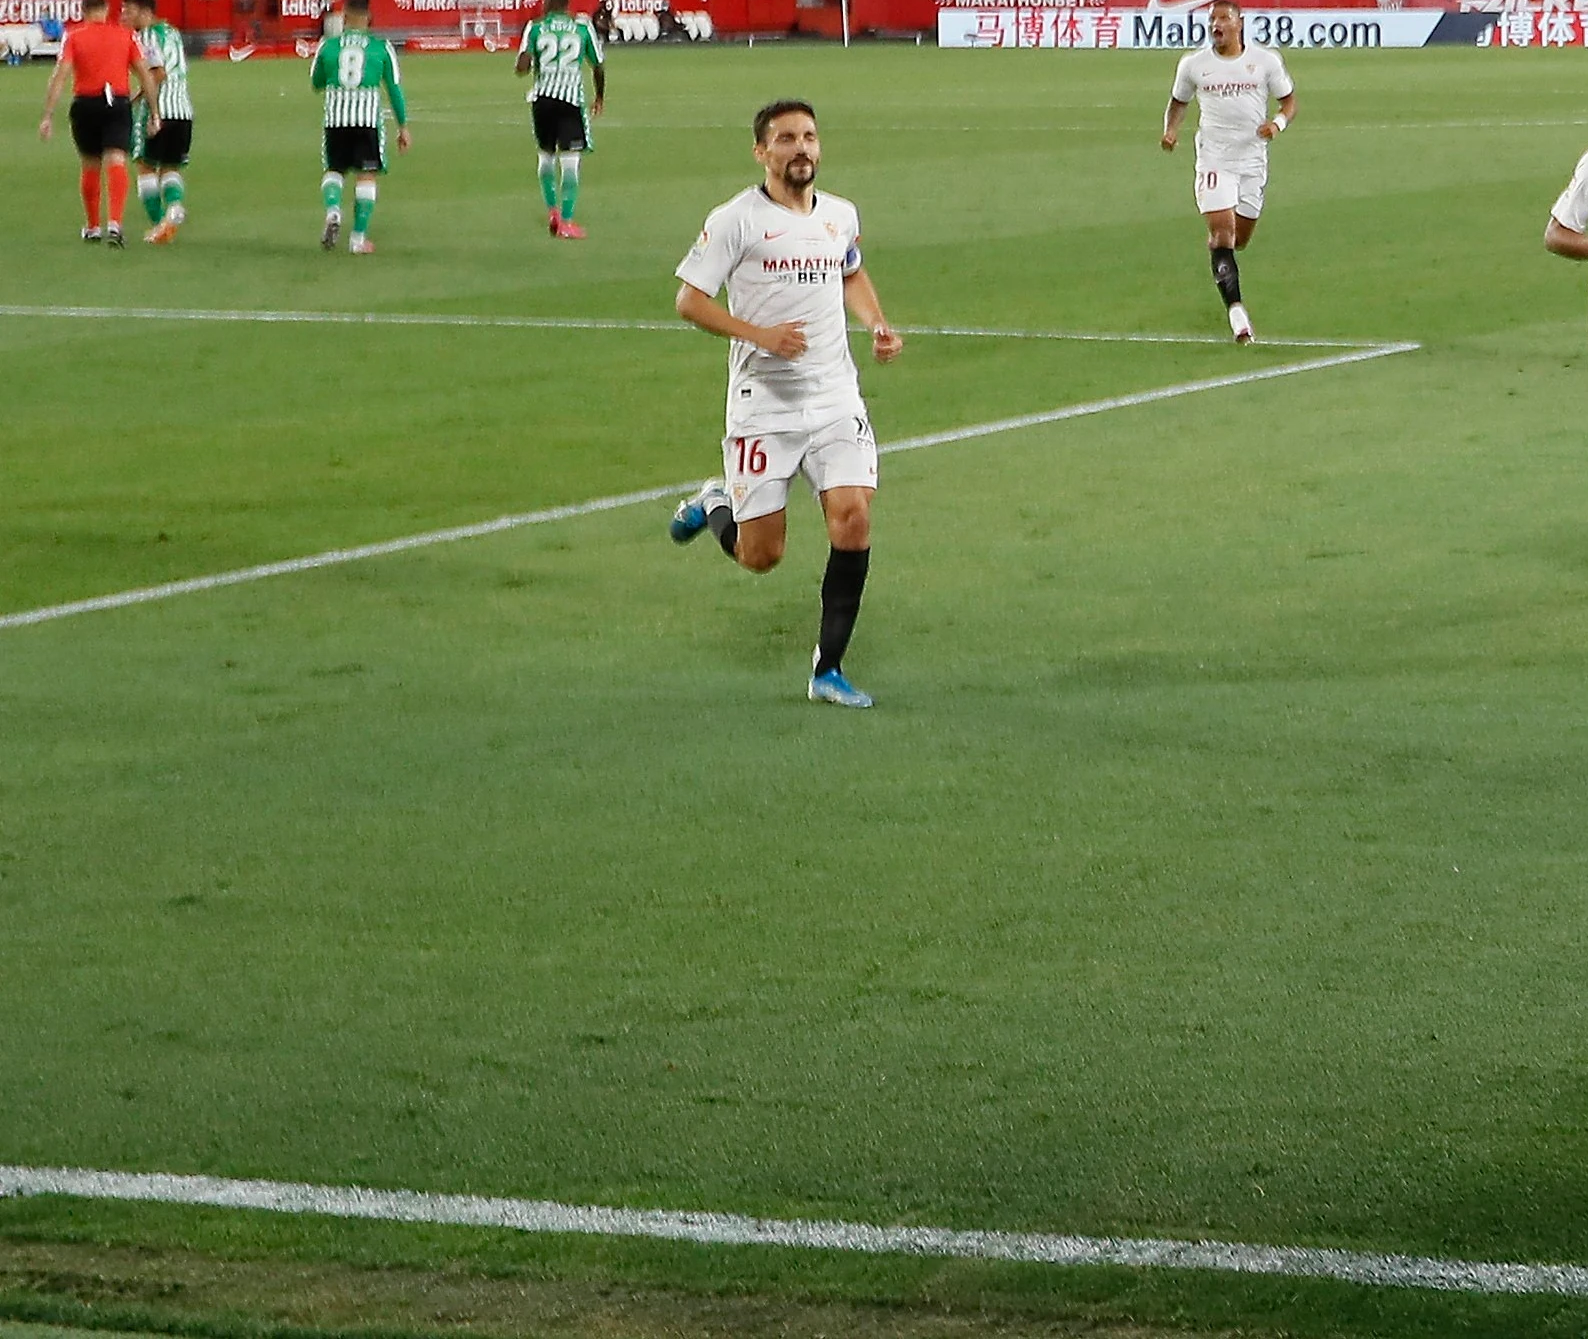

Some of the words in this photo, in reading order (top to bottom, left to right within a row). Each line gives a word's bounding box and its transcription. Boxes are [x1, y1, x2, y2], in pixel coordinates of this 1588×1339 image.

[974, 11, 1123, 47] 马博体育
[338, 46, 366, 89] 8
[536, 32, 582, 73] 22
[798, 271, 828, 285] BET
[735, 436, 768, 477] 16
